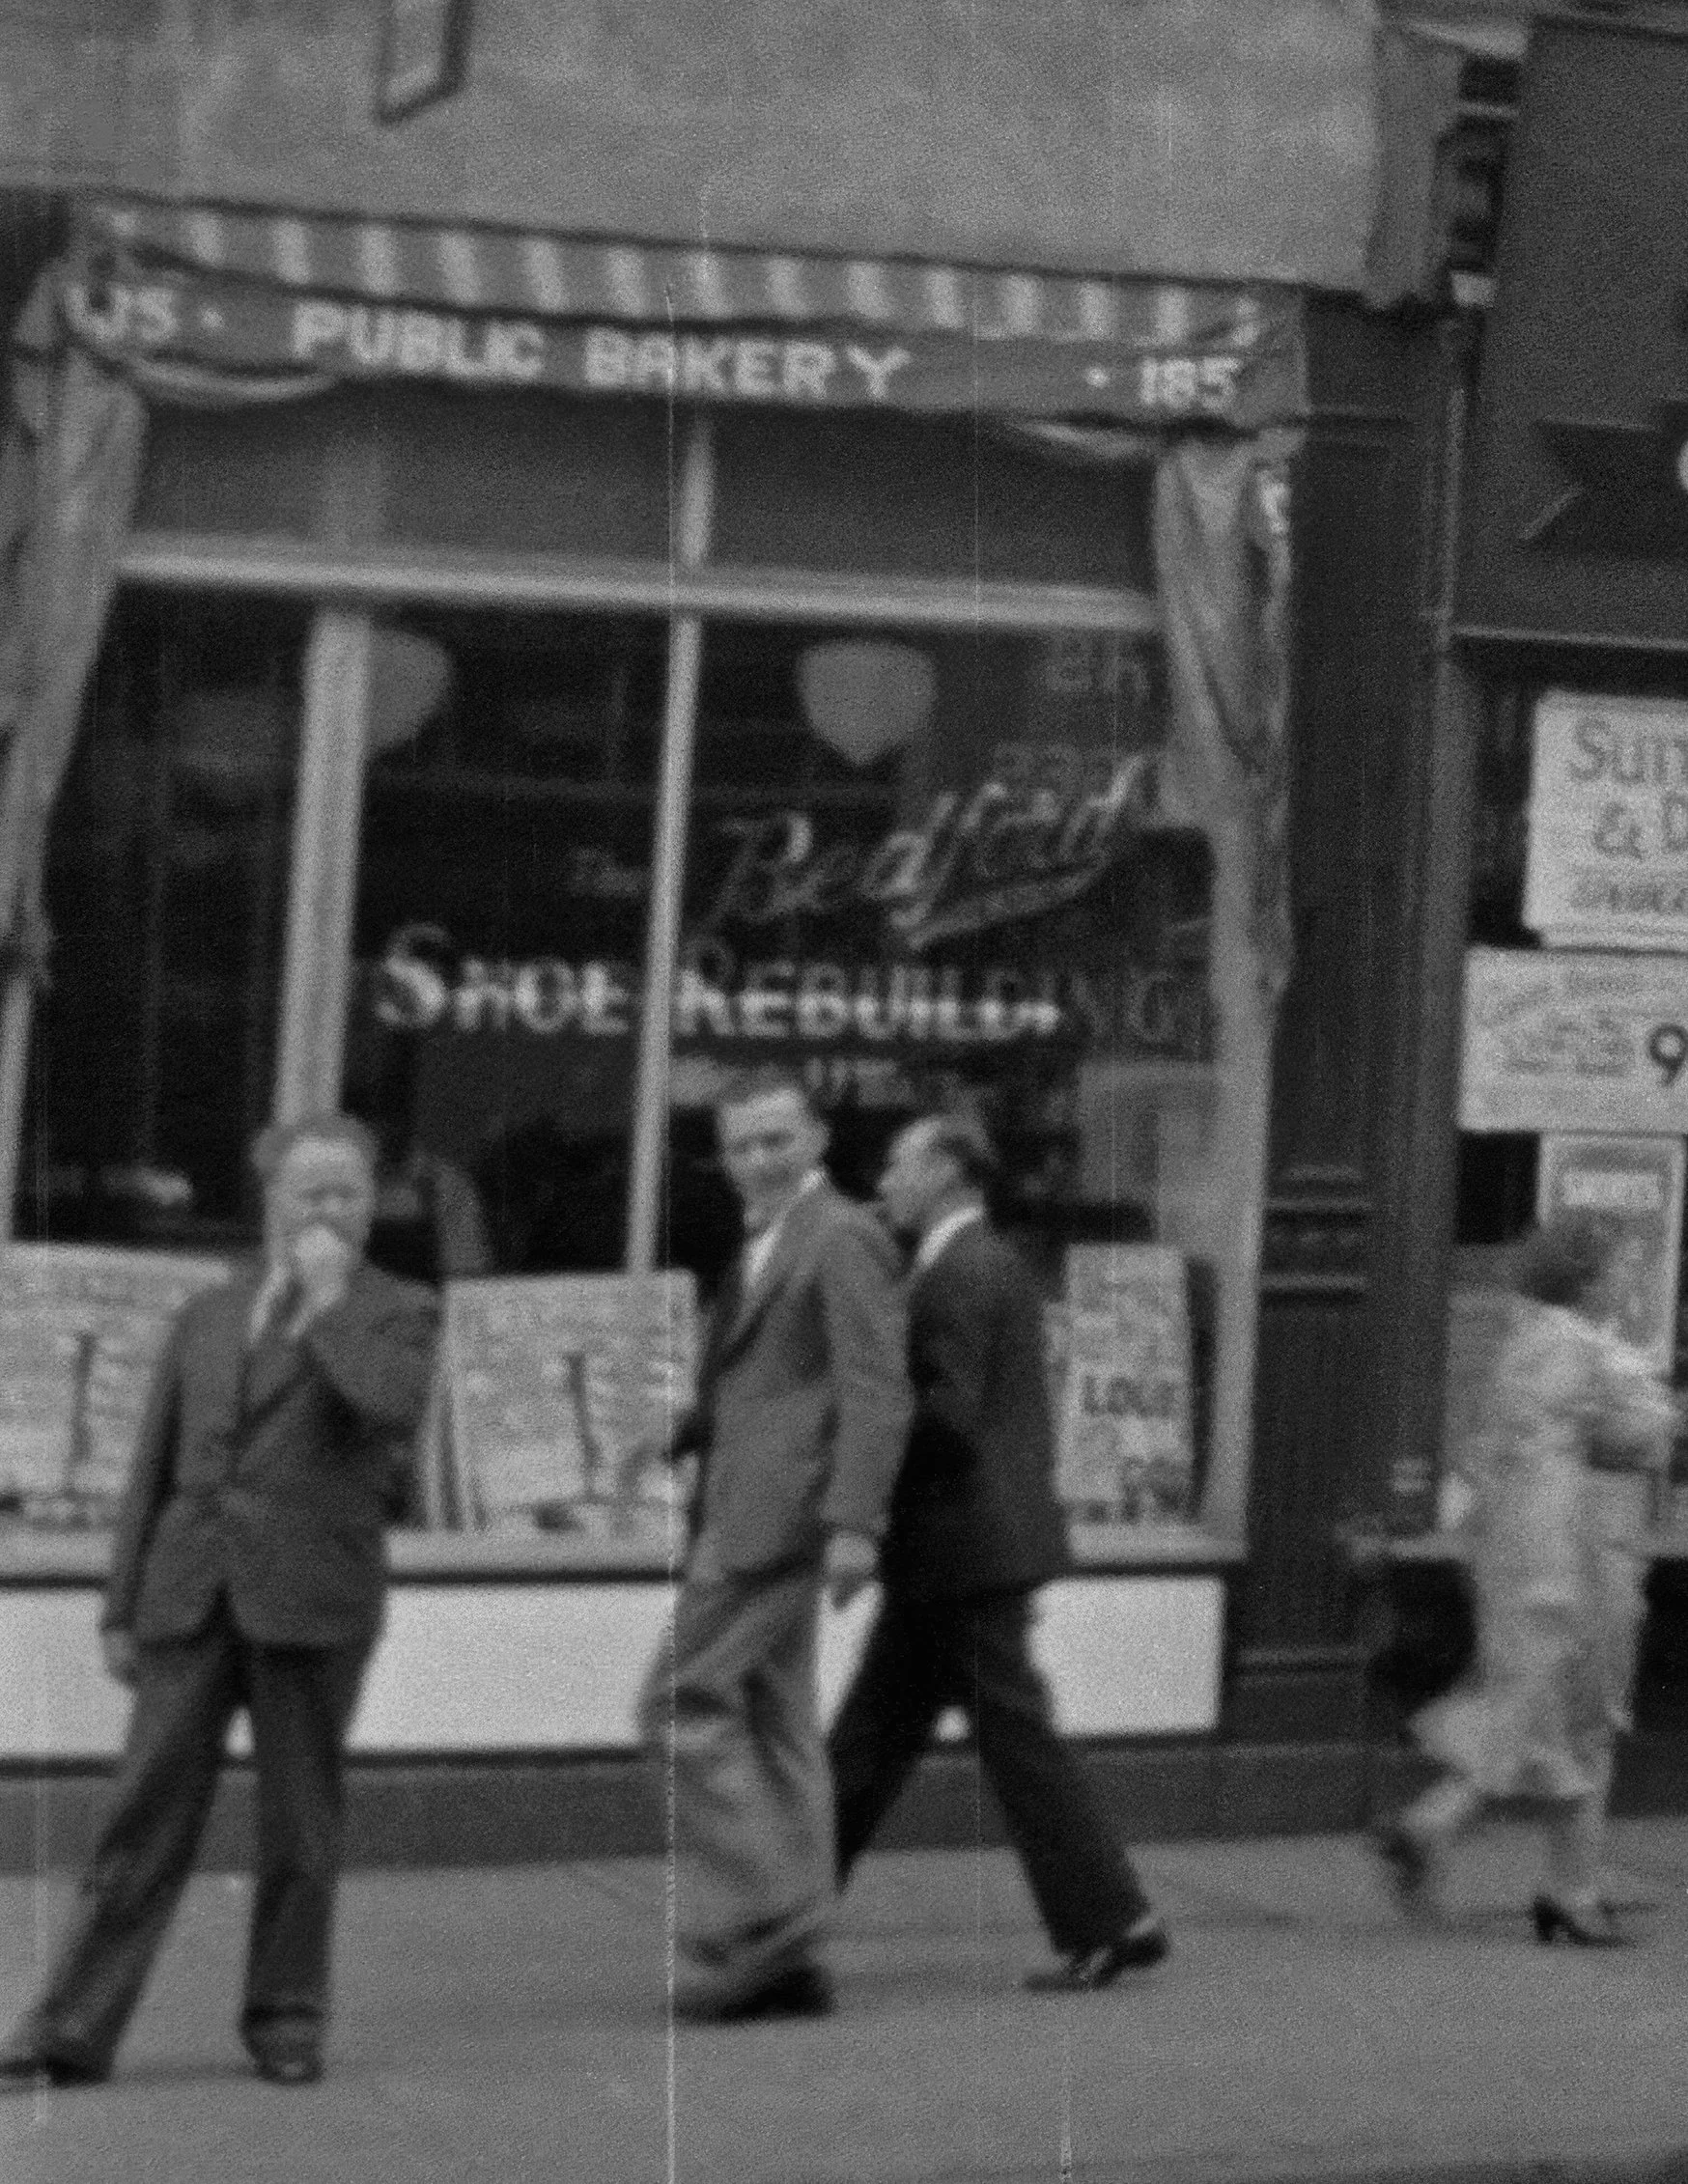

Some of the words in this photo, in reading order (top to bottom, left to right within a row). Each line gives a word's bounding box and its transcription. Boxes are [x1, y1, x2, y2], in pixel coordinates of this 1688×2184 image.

[293, 299, 546, 379] PUBLIC
[584, 329, 912, 400] BAKERY
[1139, 354, 1243, 411] 185
[1592, 800, 1645, 862] &
[375, 920, 633, 1035] SHOE
